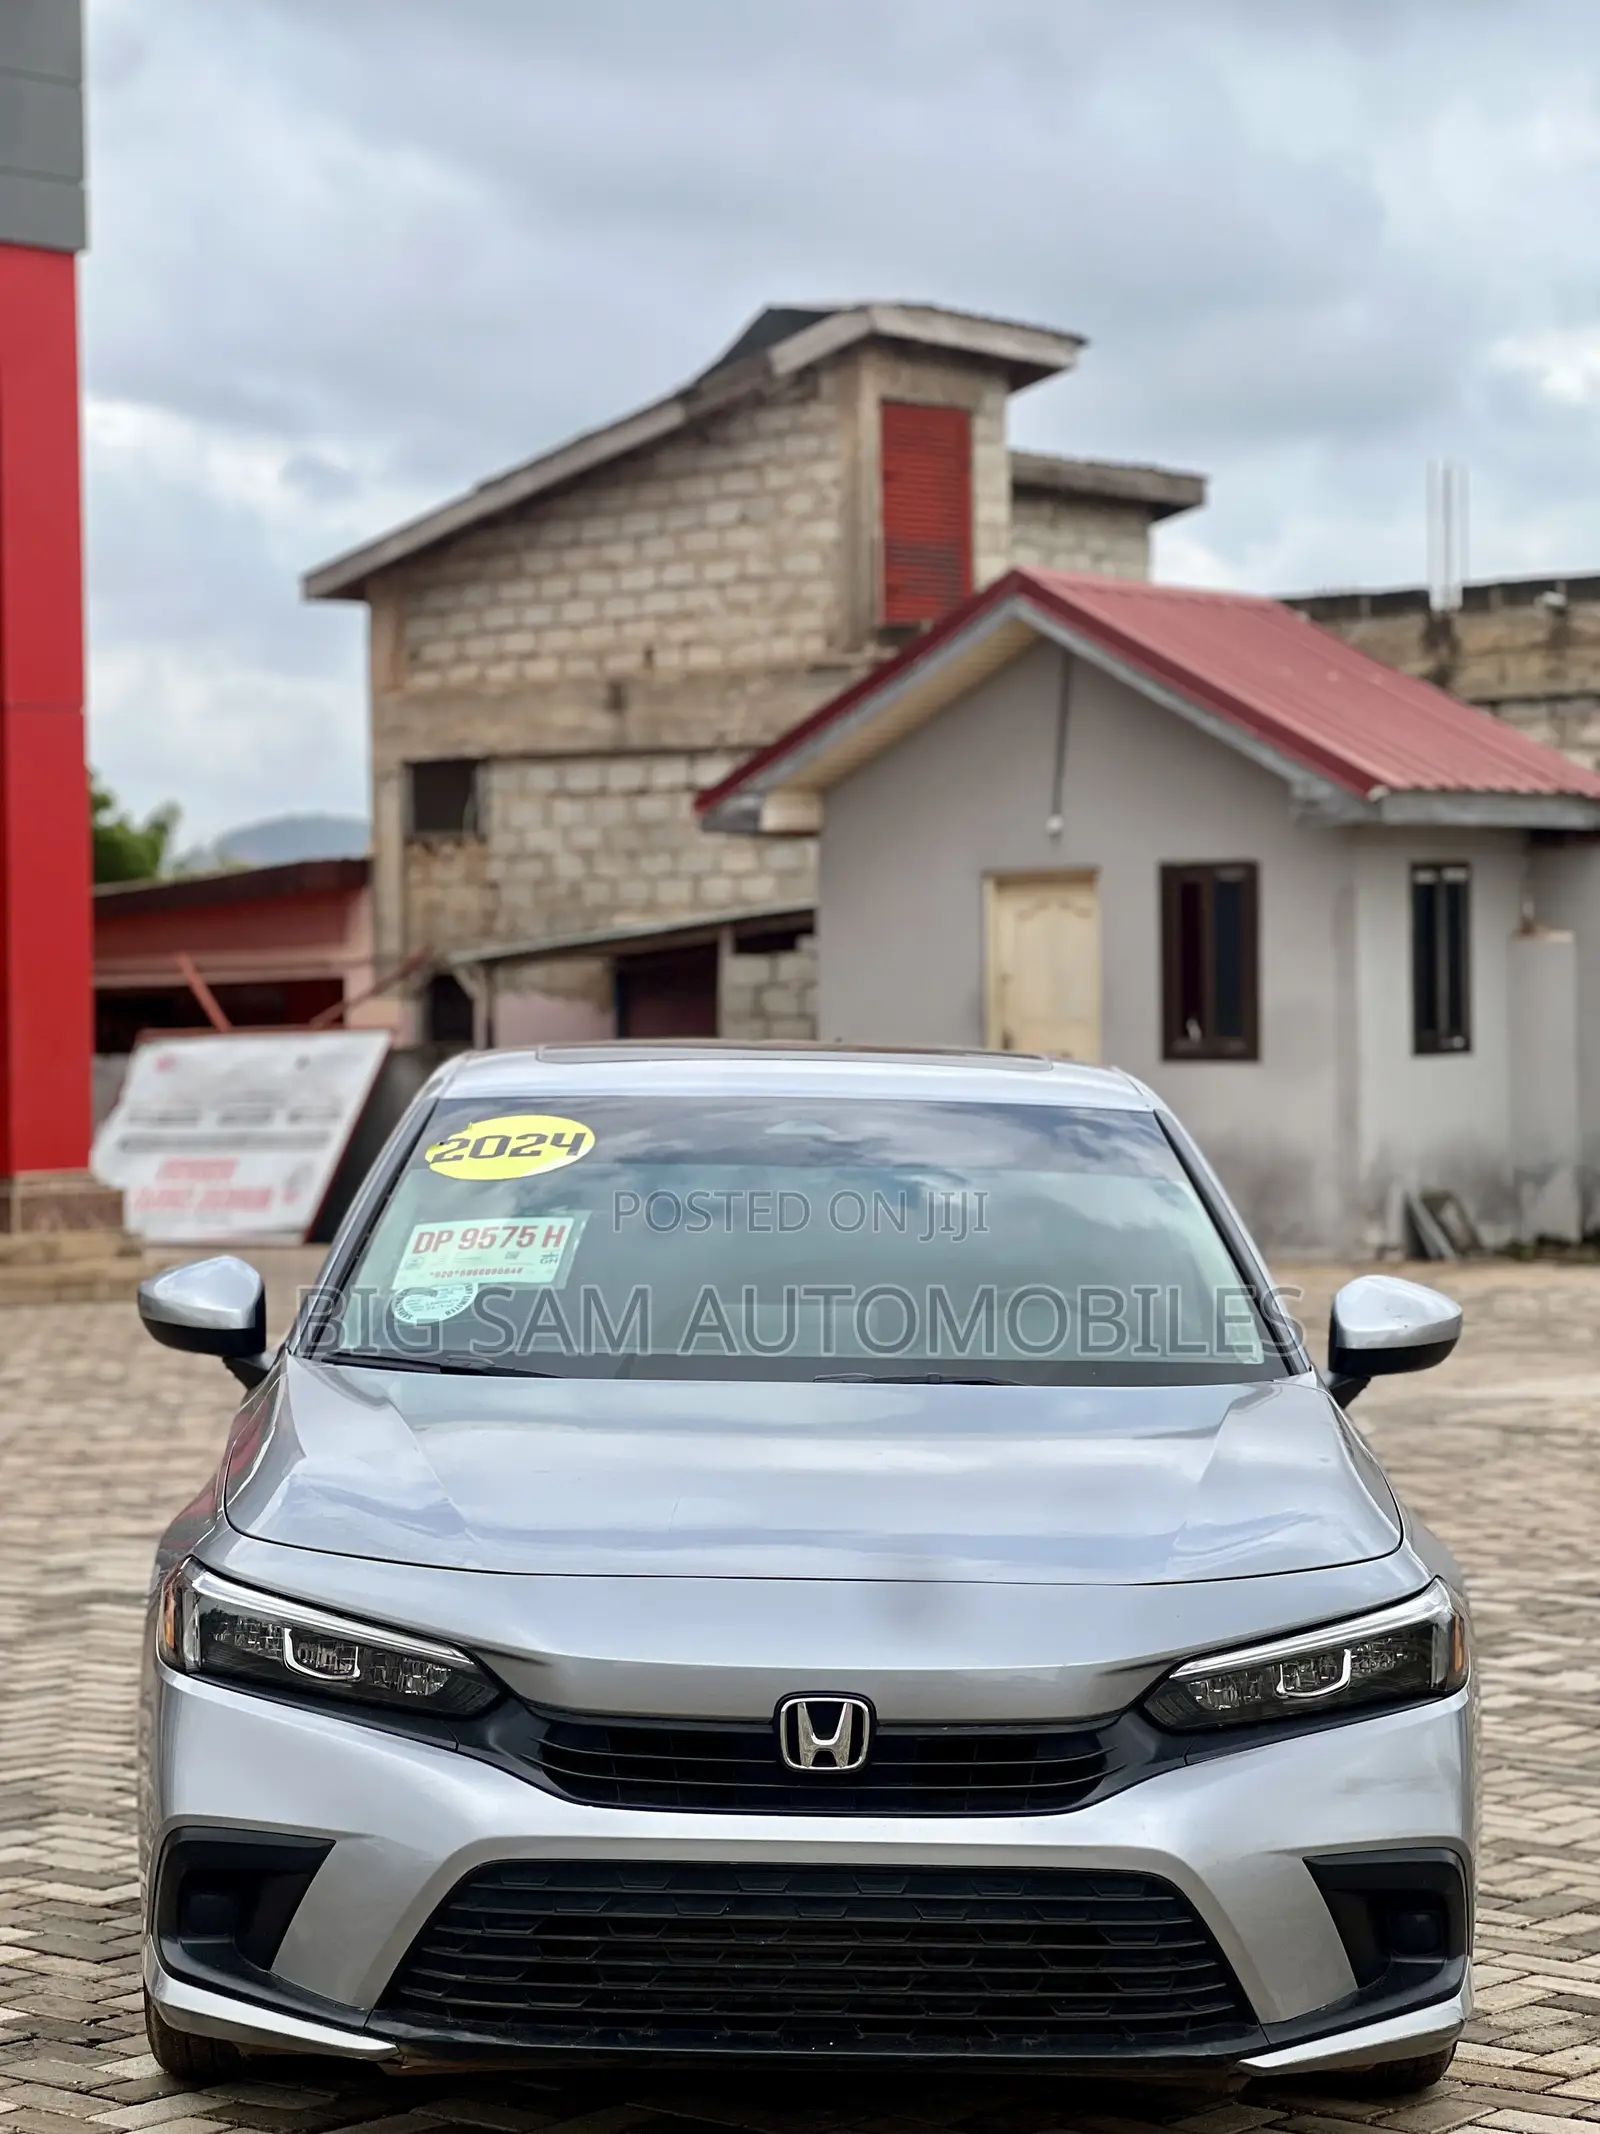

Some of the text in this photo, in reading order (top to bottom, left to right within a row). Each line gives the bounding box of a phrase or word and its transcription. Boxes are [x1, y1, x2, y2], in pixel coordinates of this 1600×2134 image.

[431, 1132, 586, 1164] 2024
[412, 1224, 567, 1254] DP 9575 H
